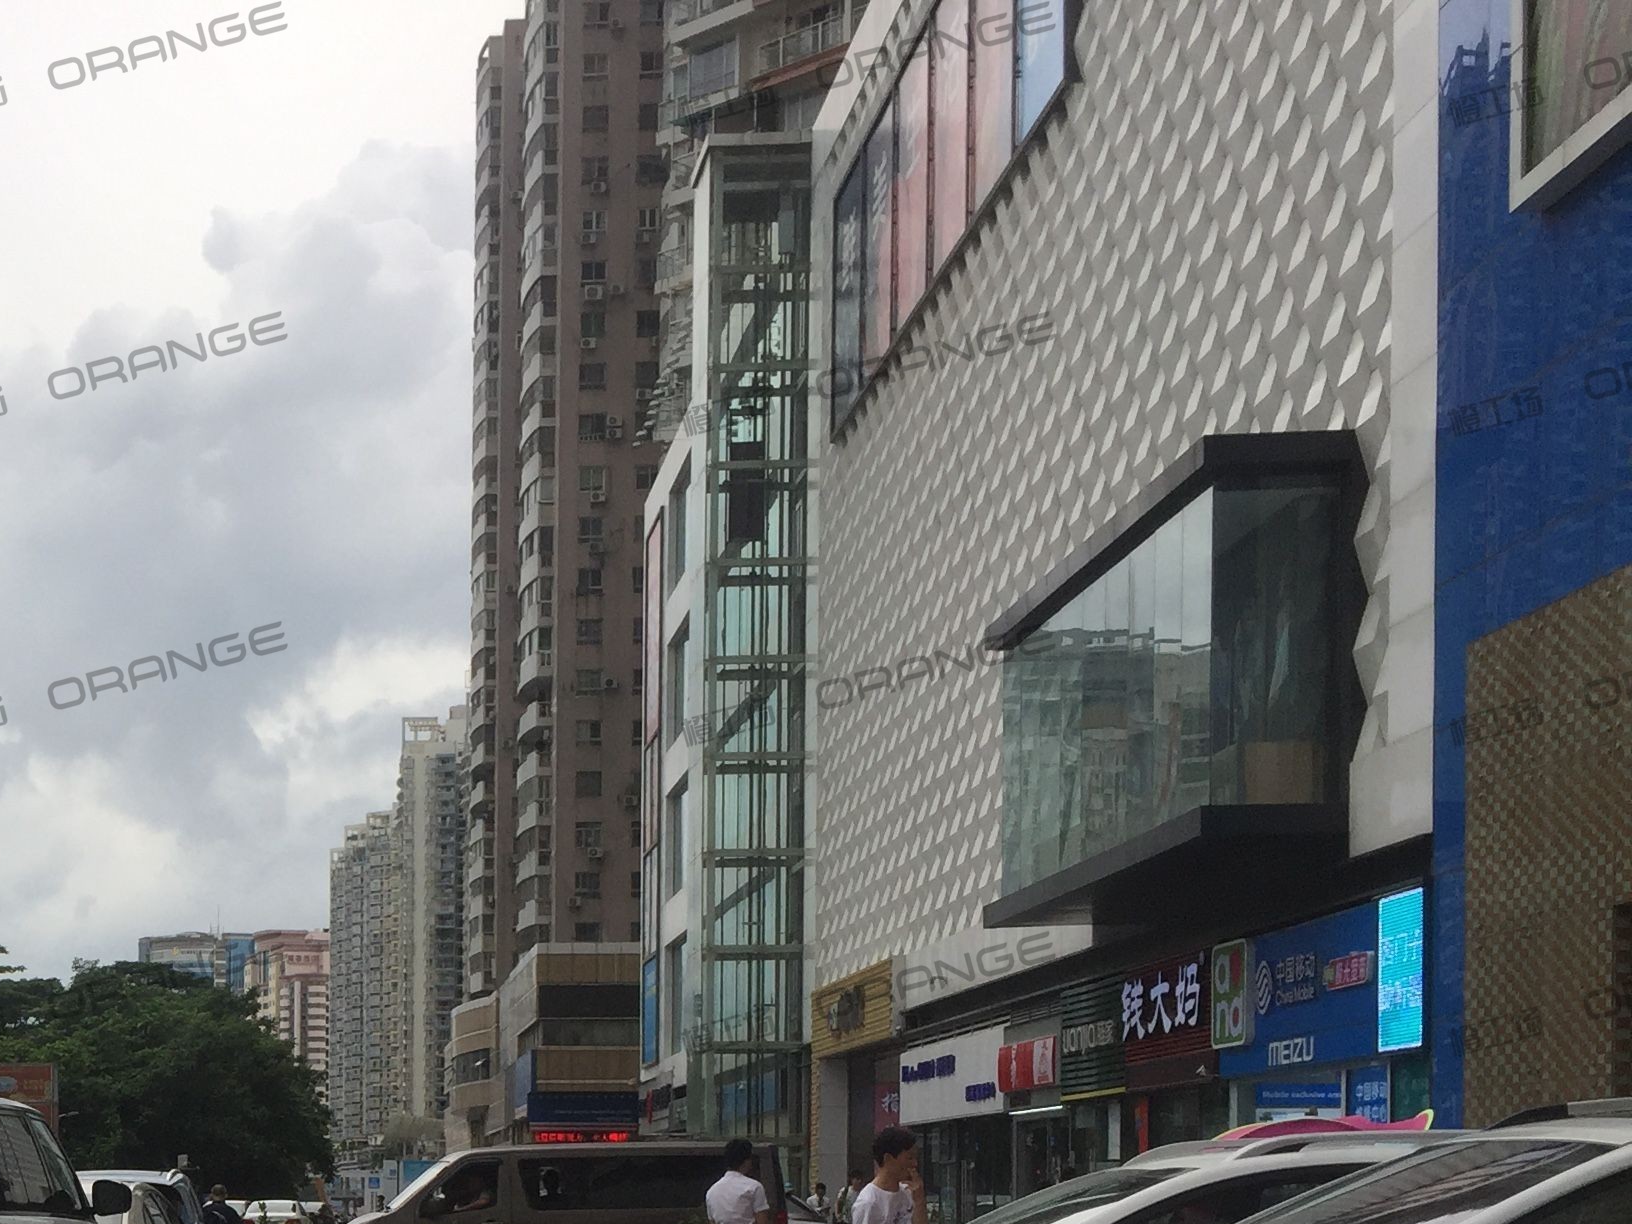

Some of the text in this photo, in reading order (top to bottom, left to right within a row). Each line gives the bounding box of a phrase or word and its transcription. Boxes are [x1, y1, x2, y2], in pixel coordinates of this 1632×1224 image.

[1275, 953, 1315, 985] 中国移动
[1121, 962, 1200, 1042] 钱大妈
[1269, 1035, 1314, 1067] MEIZU
